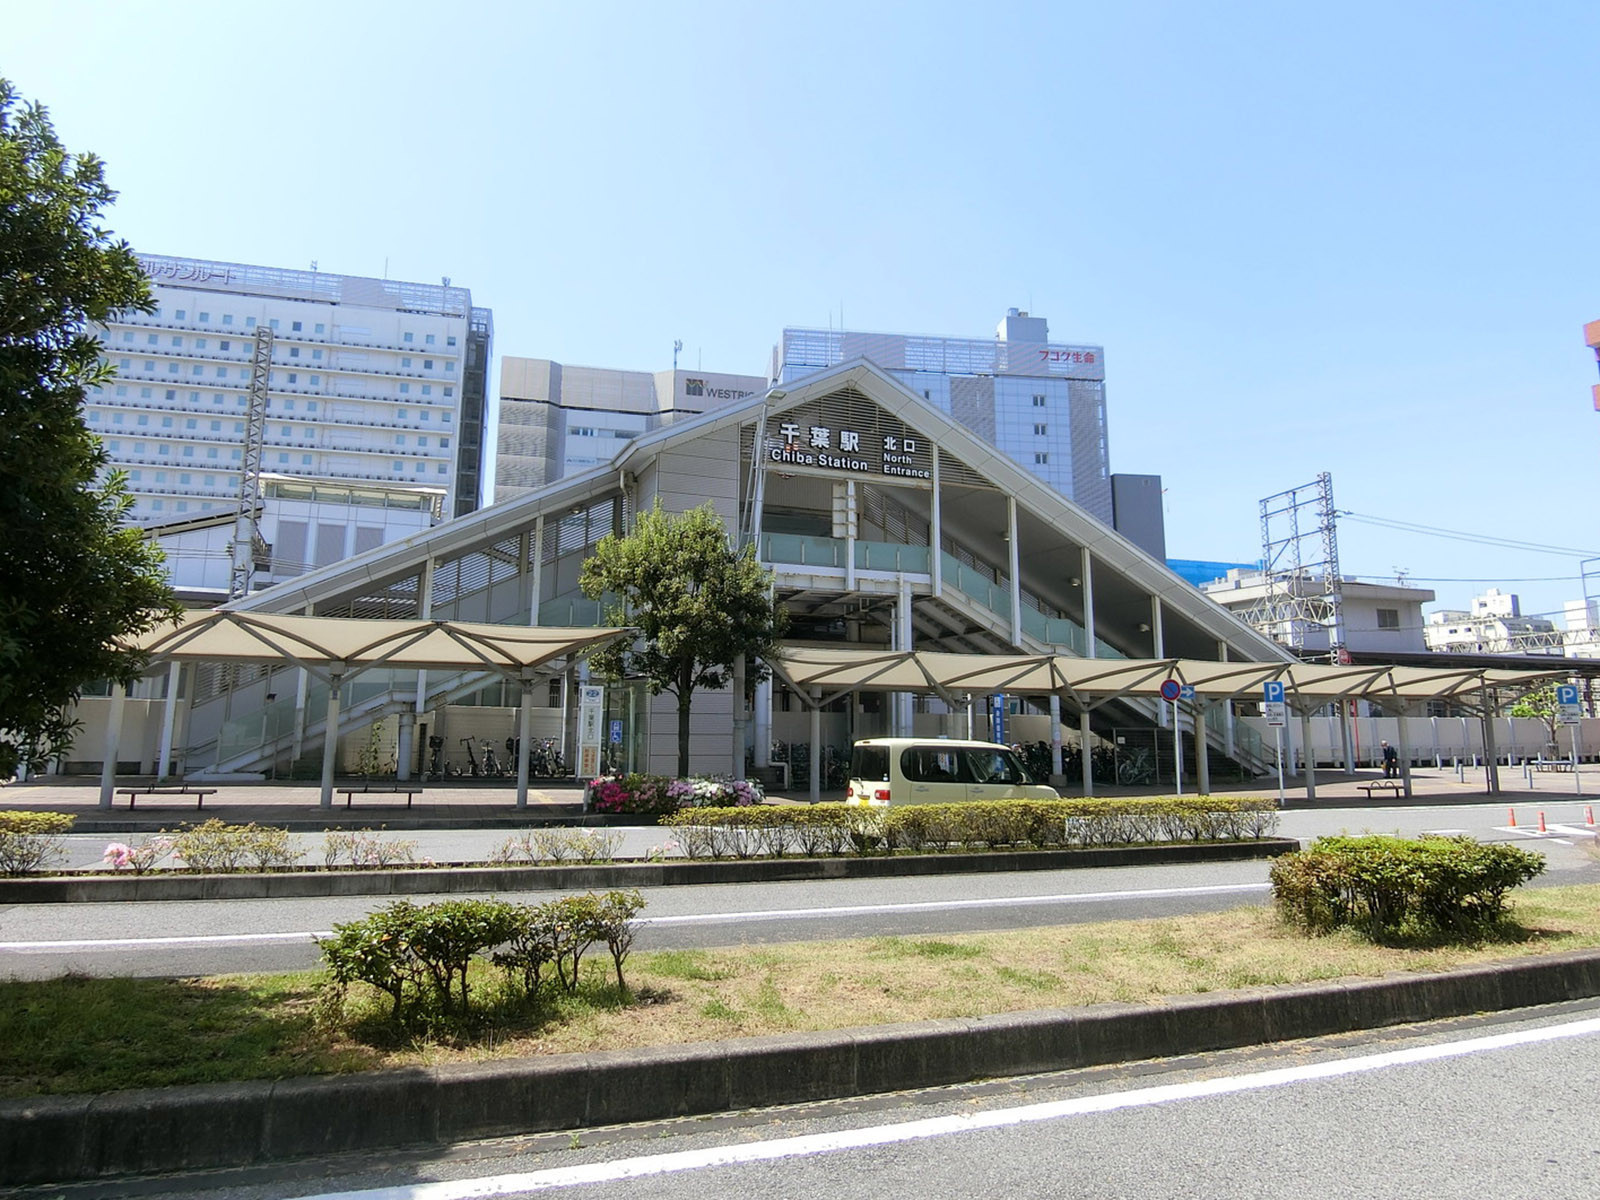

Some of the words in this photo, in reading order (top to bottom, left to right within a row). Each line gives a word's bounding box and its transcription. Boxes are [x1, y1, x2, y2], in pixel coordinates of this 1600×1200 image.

[1039, 350, 1095, 363] フコク生命
[780, 423, 860, 452] 千葉駅
[883, 436, 916, 453] 北口
[771, 449, 813, 464] Chiba
[818, 456, 868, 471] Station
[883, 452, 912, 464] North
[883, 465, 930, 478] Entrance
[1268, 683, 1280, 701] P
[1561, 687, 1574, 703] P
